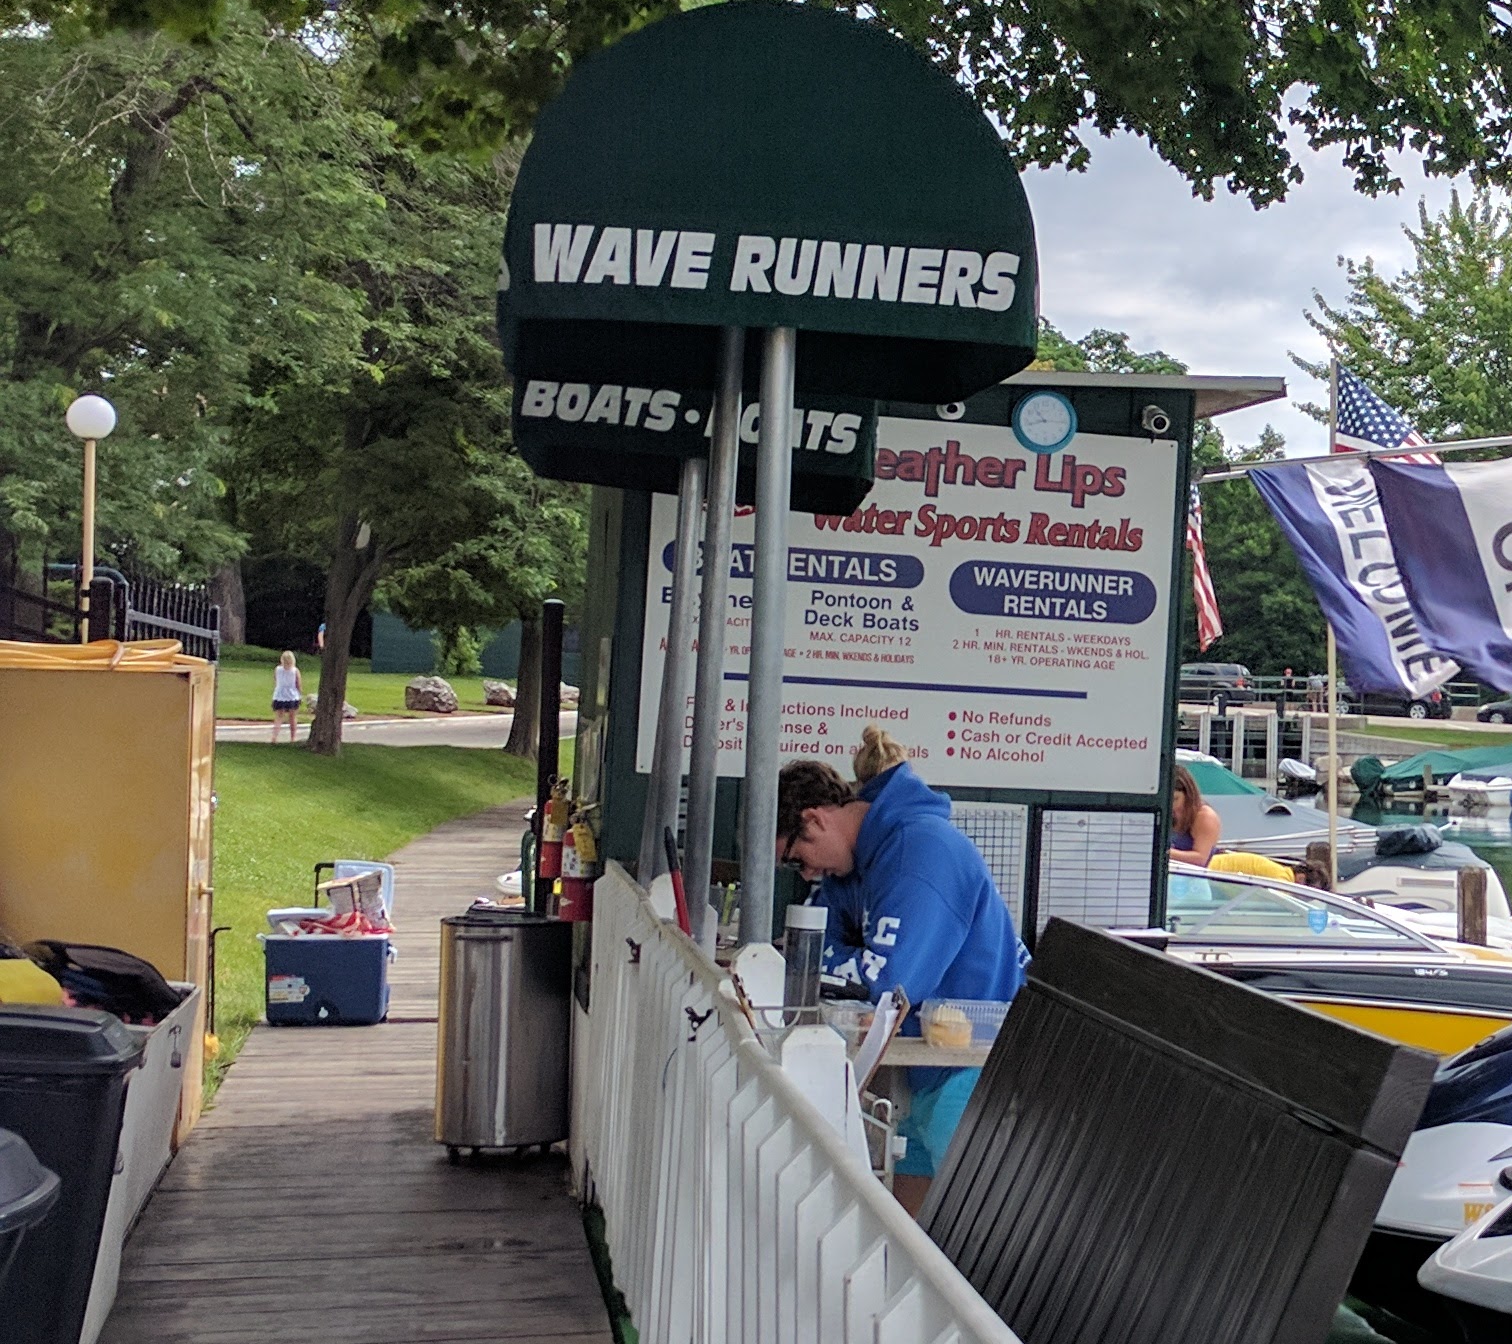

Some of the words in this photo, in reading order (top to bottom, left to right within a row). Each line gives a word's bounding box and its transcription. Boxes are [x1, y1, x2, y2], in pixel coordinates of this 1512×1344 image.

[533, 222, 716, 290] WAVE
[730, 234, 1020, 312] RUNNERS
[521, 379, 682, 432] BOATS
[704, 403, 862, 455] OTS
[875, 440, 1026, 497] eather
[1034, 453, 1127, 509] Lips
[813, 503, 912, 535] Water
[914, 504, 1020, 547] Sports
[1023, 511, 1144, 552] Rentals
[788, 552, 898, 583] ENTALS
[973, 566, 1134, 596] WAVERUNNER
[811, 590, 892, 610] Pontoon
[901, 596, 915, 612] &
[1003, 594, 1108, 621] RENTALS
[804, 609, 854, 628] Deck
[862, 613, 920, 632] Boats
[809, 630, 837, 642] MAX.
[839, 632, 895, 646] CAPACITY
[898, 637, 912, 647] 12
[974, 628, 980, 637] 1
[995, 629, 1014, 639] HR.
[1016, 630, 1065, 643] RENTALS
[1073, 634, 1132, 647] WEEKDAYS
[952, 639, 959, 650] 2
[962, 641, 981, 651] HR.
[983, 642, 1007, 652] MIN.
[1009, 643, 1059, 655] RENTALS
[1066, 646, 1113, 658] WKENDS
[1115, 648, 1123, 658] &
[1124, 650, 1150, 660] HOL.
[1010, 655, 1027, 666] YR.
[1029, 657, 1091, 669] OPERATING
[1093, 660, 1116, 670] AGE
[724, 698, 736, 712] &
[840, 707, 909, 721] Included
[962, 710, 984, 724] No
[989, 711, 1052, 727] Refunds
[817, 722, 829, 736] &
[961, 728, 1000, 743] Cash
[1005, 733, 1021, 744] or
[1025, 731, 1072, 747] Credit
[1076, 735, 1148, 752] Accepted
[825, 743, 844, 755] on
[960, 746, 982, 760] No
[986, 748, 1045, 763] Alcohol
